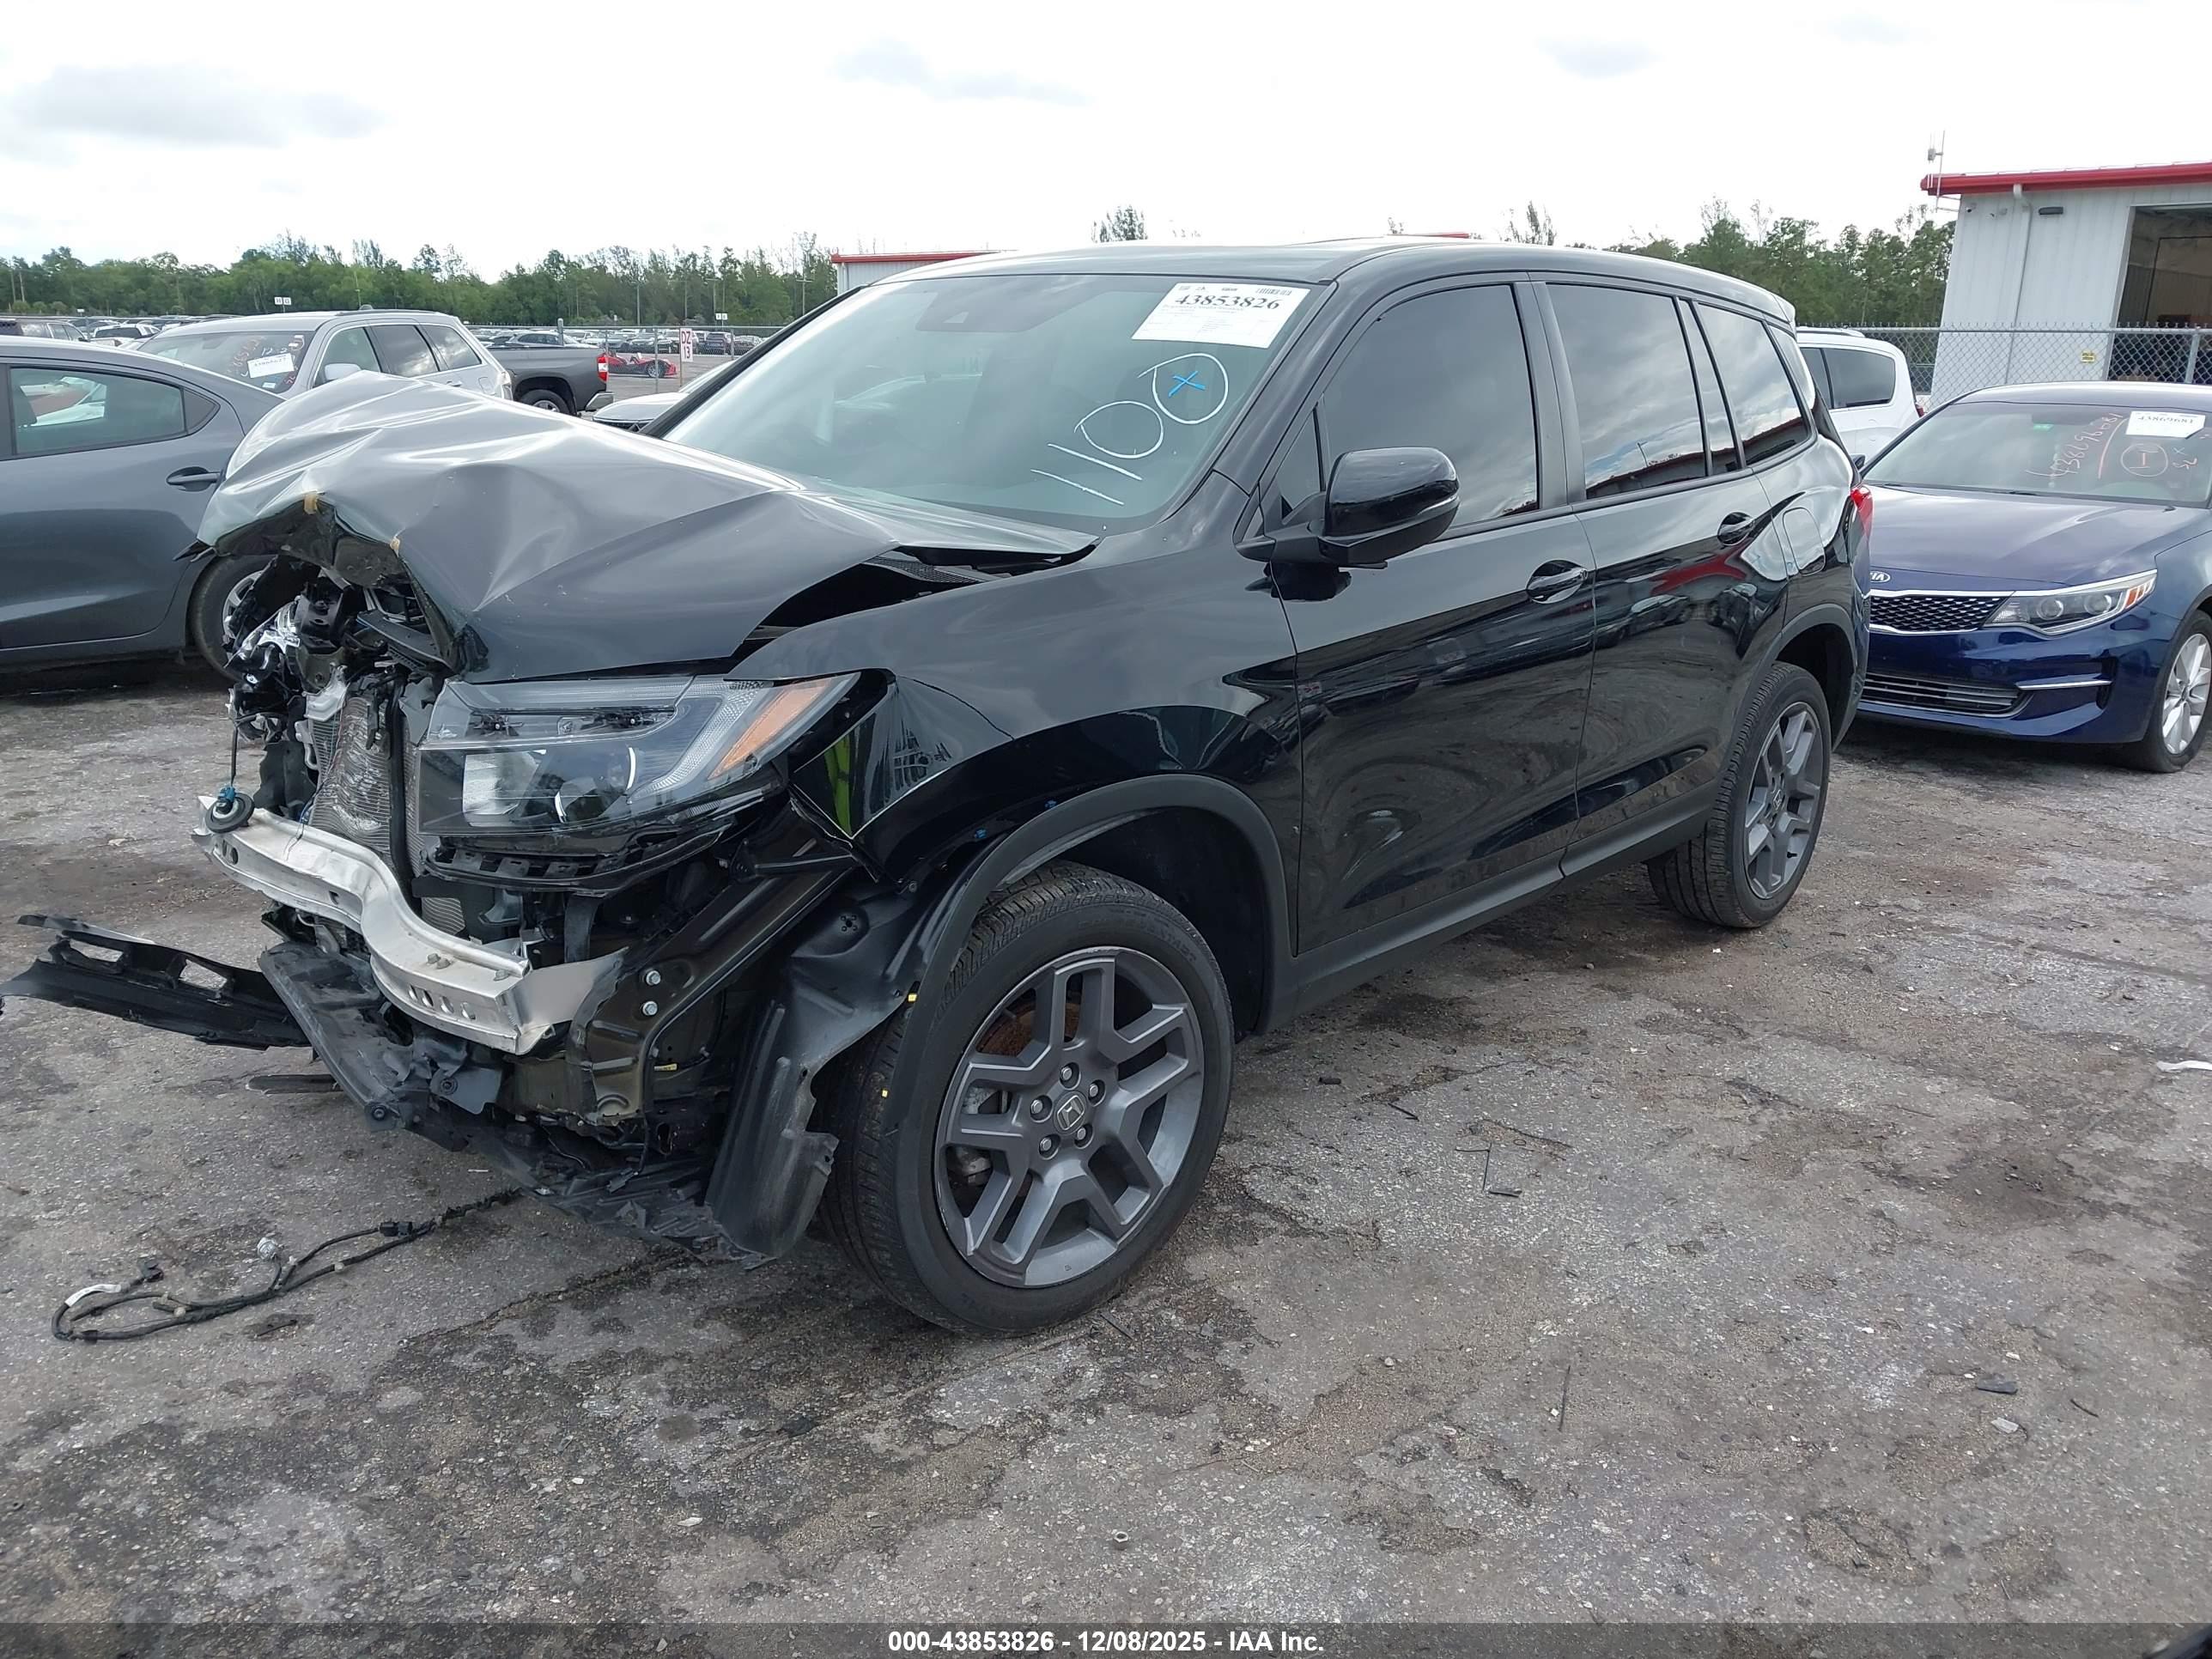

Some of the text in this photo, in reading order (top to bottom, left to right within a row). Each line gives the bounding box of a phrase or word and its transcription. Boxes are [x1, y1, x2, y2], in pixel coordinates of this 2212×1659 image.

[1175, 294, 1284, 310] 43853826
[681, 331, 691, 344] DZ
[684, 345, 690, 359] 13
[1869, 571, 1885, 580] IA
